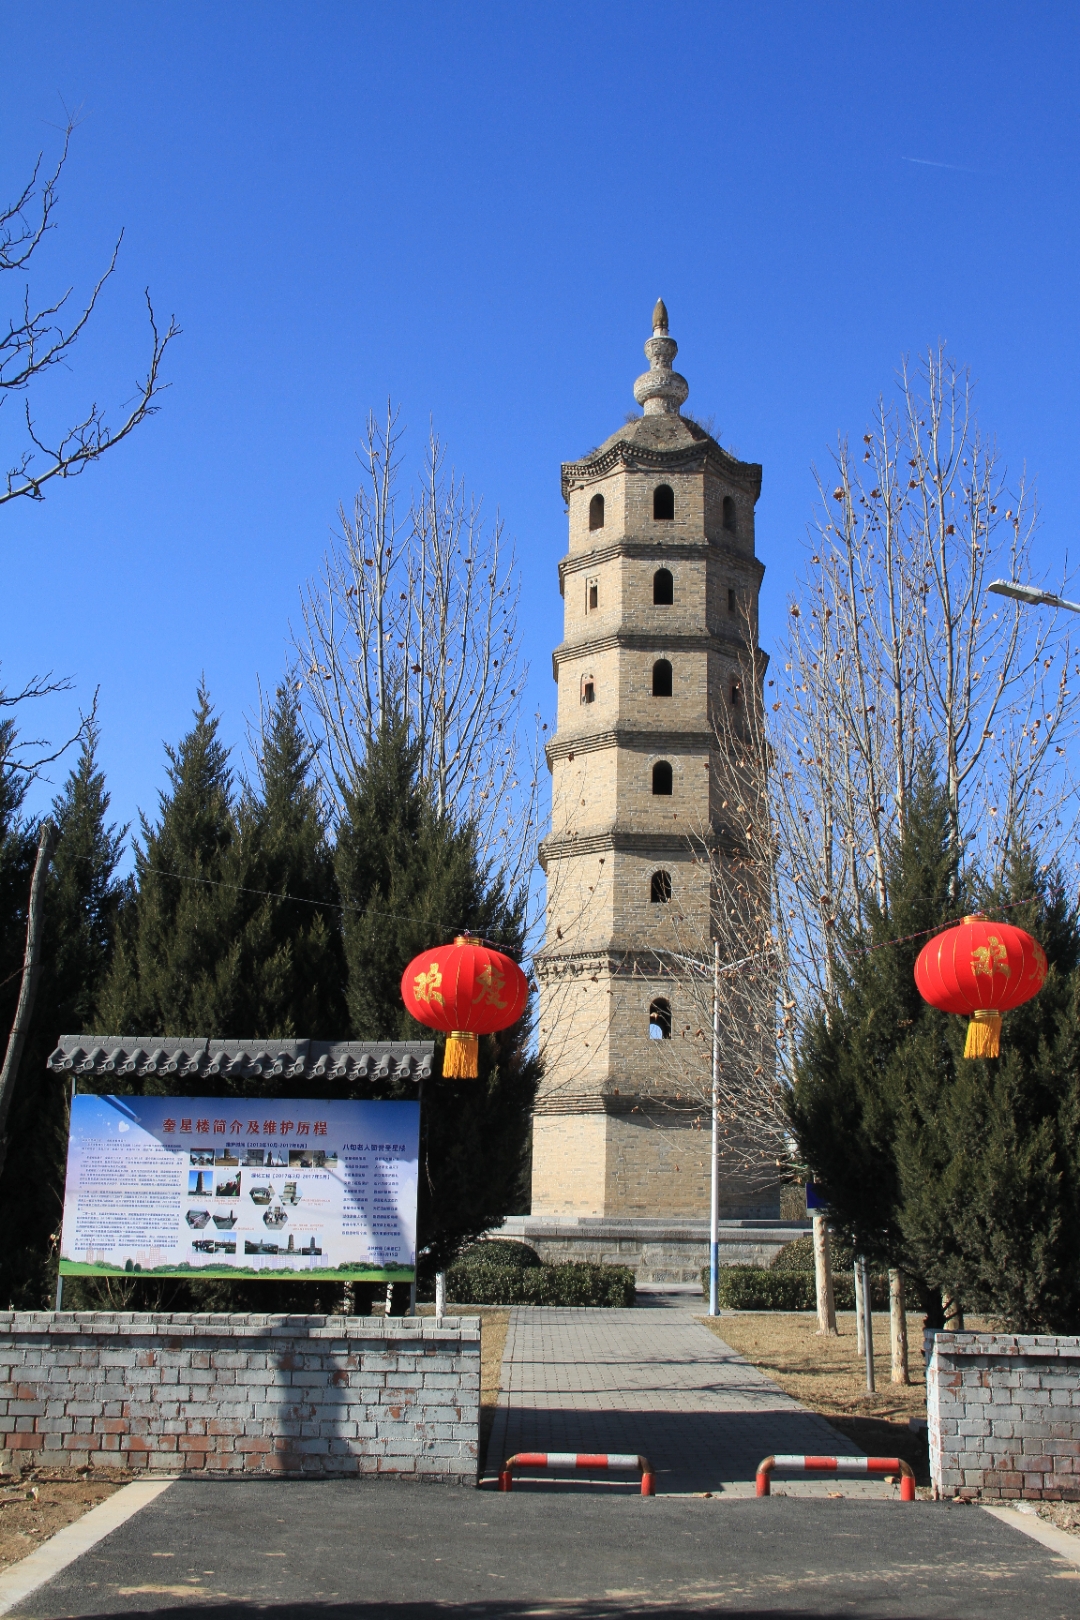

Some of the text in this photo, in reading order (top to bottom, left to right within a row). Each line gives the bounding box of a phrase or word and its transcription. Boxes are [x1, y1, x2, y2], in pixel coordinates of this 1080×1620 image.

[162, 1118, 328, 1135] 奎星楼简介及维护历程
